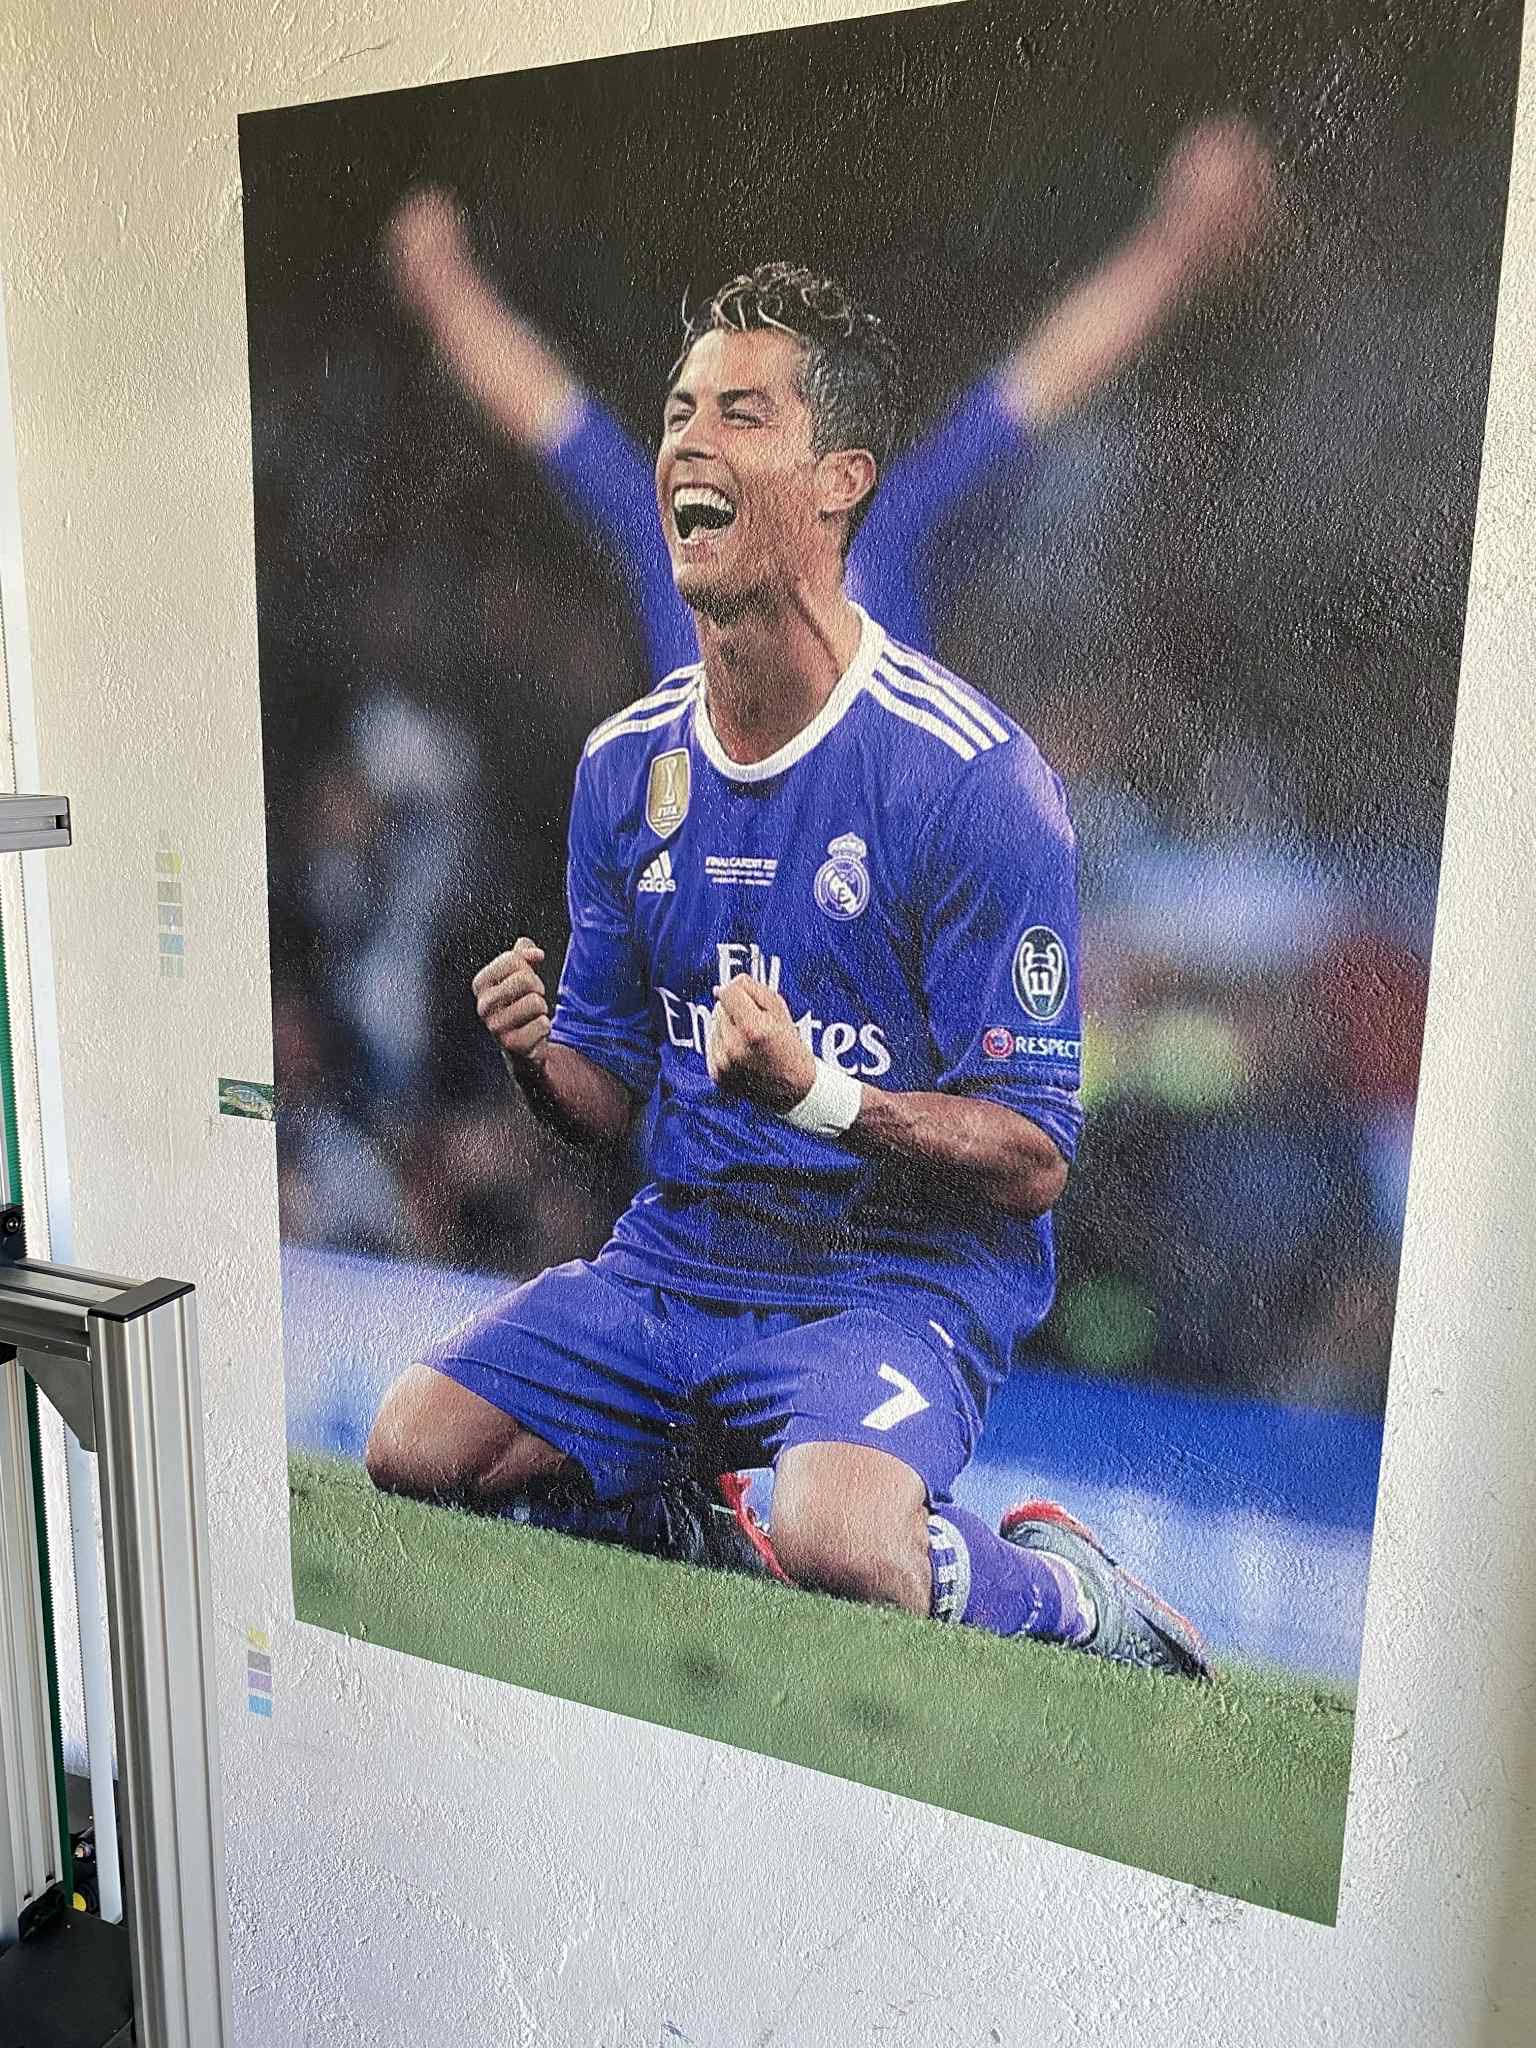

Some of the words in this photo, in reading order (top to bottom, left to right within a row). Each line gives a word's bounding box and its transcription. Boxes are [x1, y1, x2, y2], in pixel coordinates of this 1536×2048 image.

[1030, 971, 1051, 995] 11
[1015, 1036, 1080, 1059] RESPECT
[860, 1362, 930, 1431] 7
